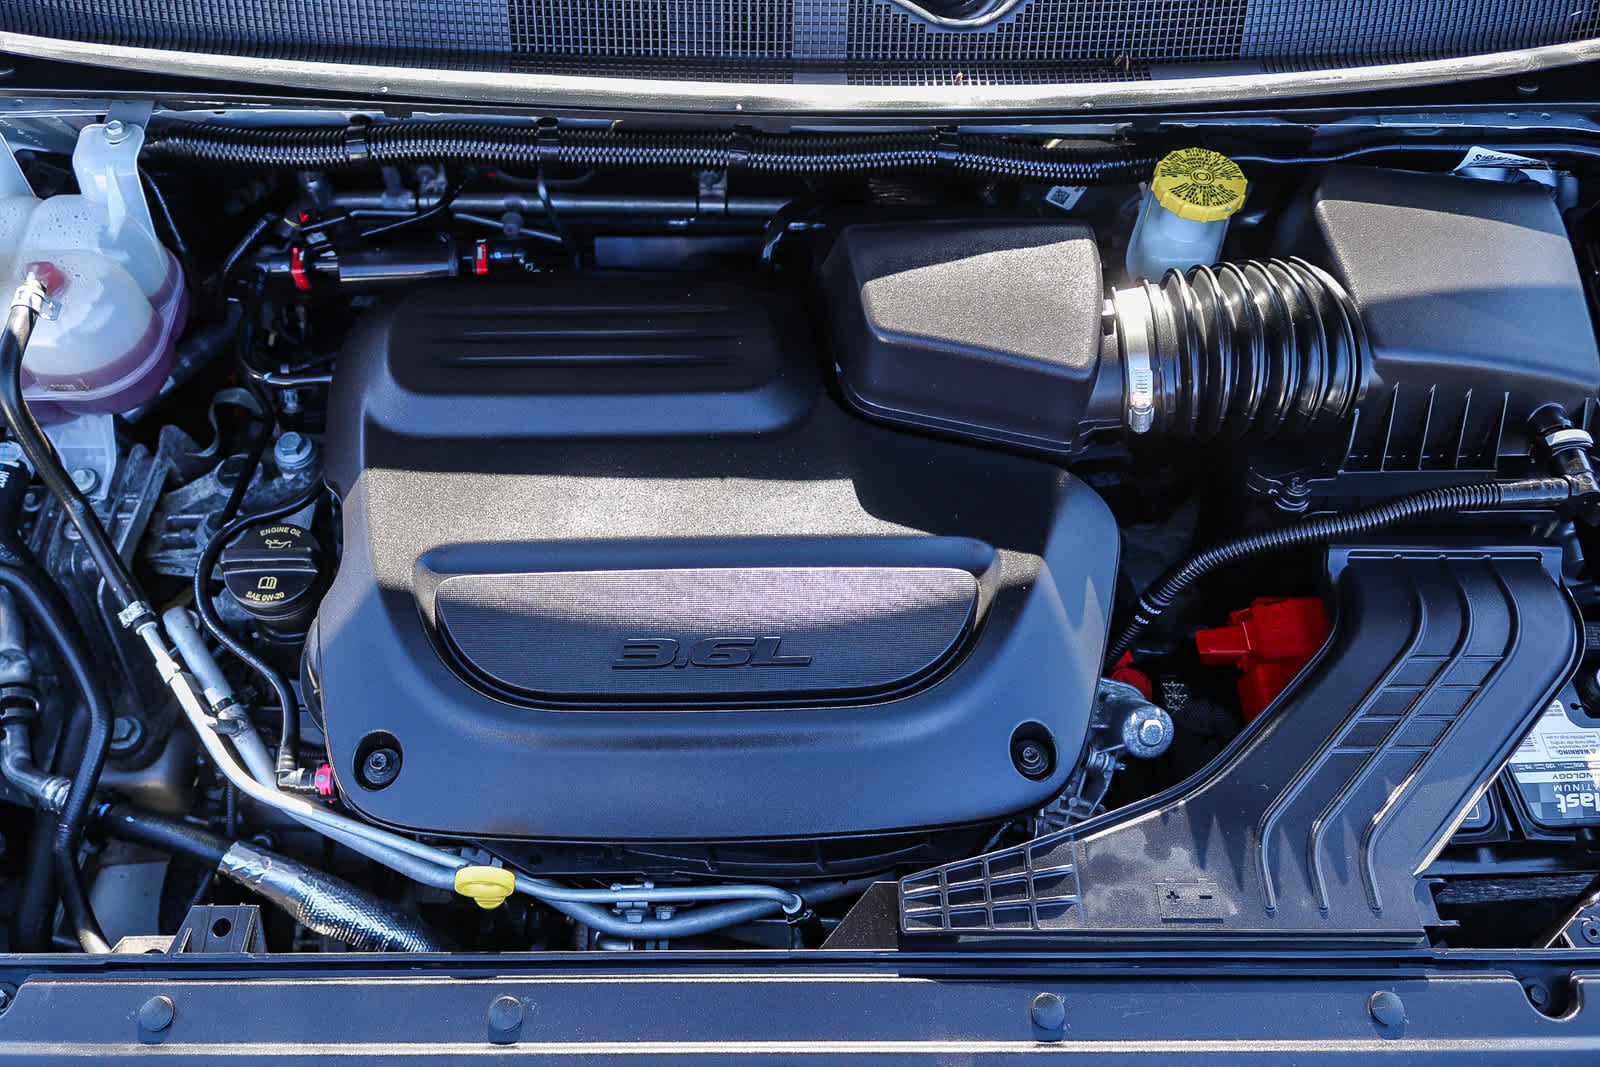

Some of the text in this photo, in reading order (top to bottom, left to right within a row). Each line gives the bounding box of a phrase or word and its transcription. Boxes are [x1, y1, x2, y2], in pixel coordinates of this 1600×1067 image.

[260, 526, 302, 538] ENGINE OIL
[245, 591, 261, 601] SAE
[612, 636, 813, 670] 3.6L
[1555, 792, 1600, 814] last
